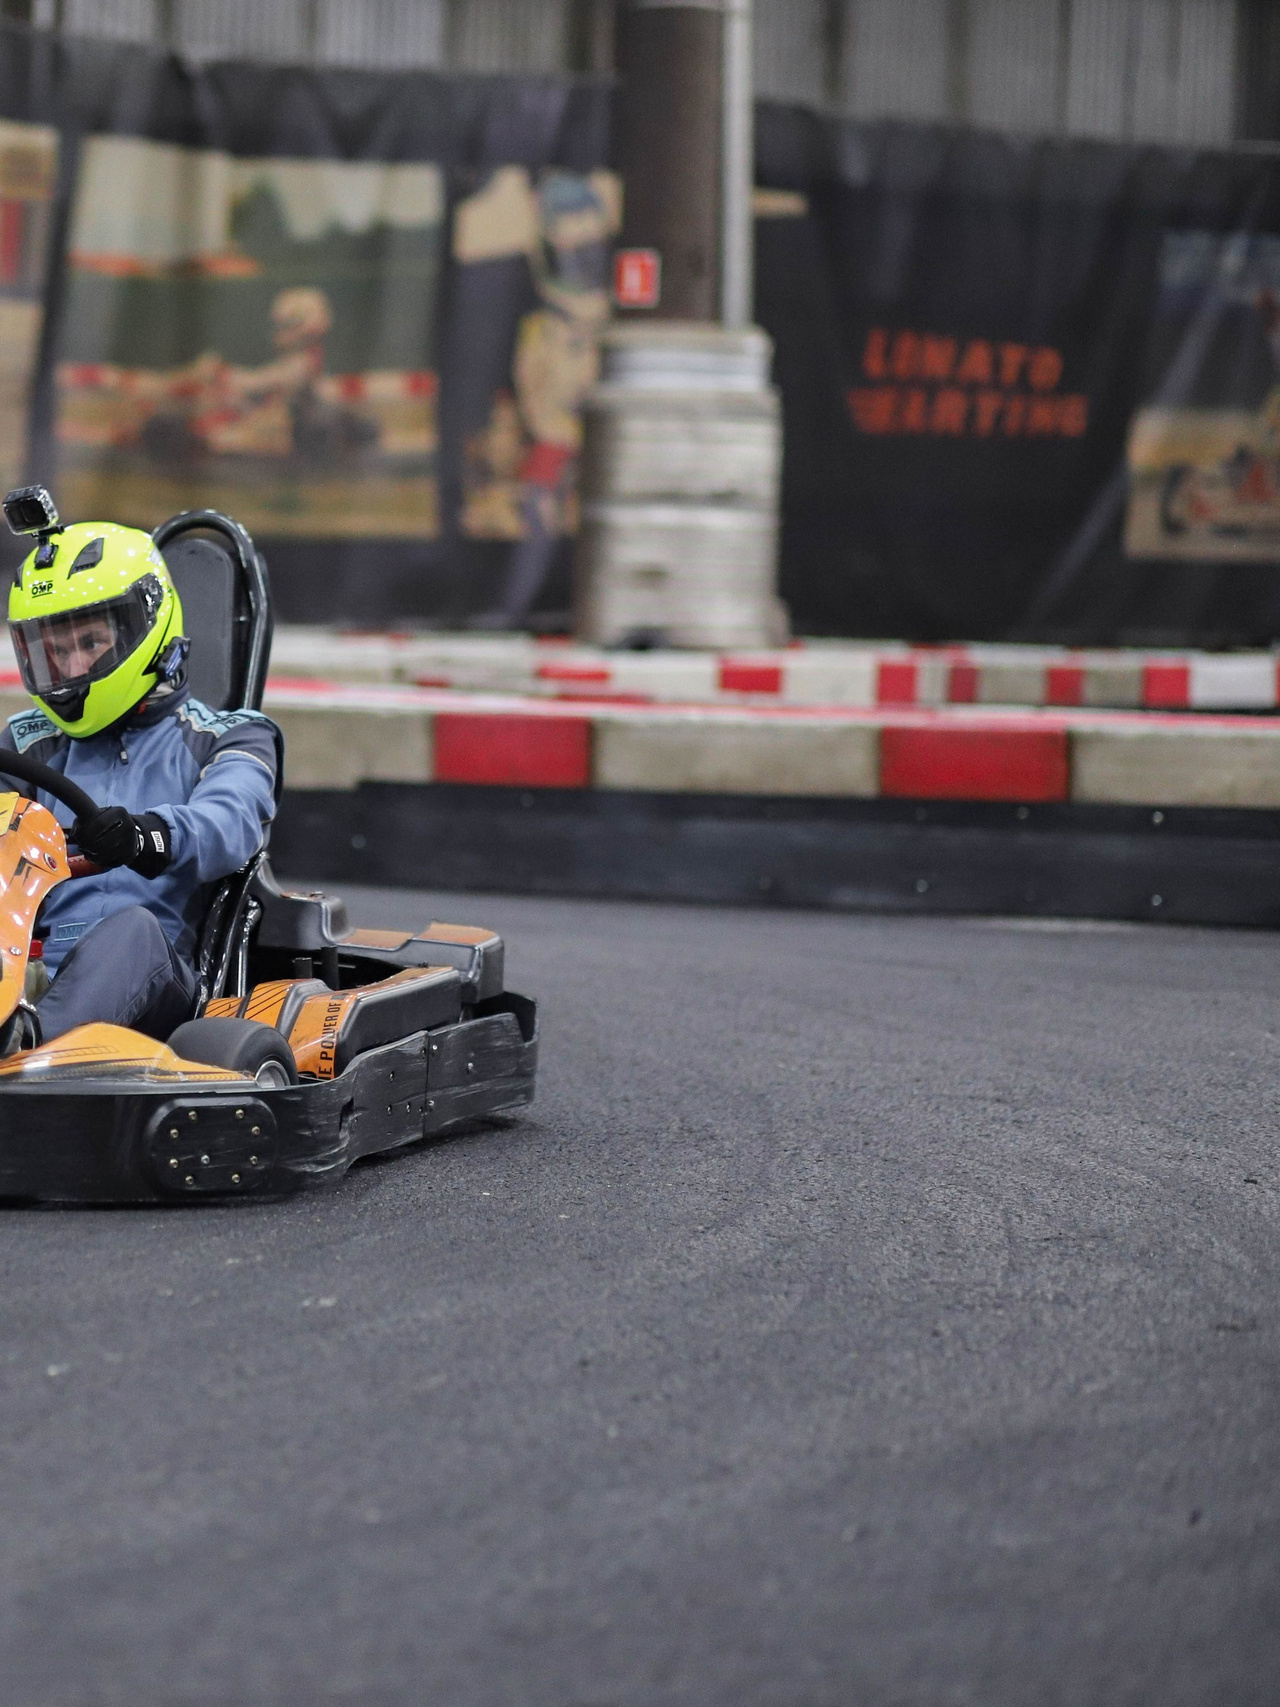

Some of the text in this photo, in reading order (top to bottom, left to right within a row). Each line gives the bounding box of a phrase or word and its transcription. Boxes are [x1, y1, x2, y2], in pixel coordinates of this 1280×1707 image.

[31, 582, 54, 595] OMP
[327, 1002, 342, 1013] OF
[320, 1015, 339, 1061] POWER
